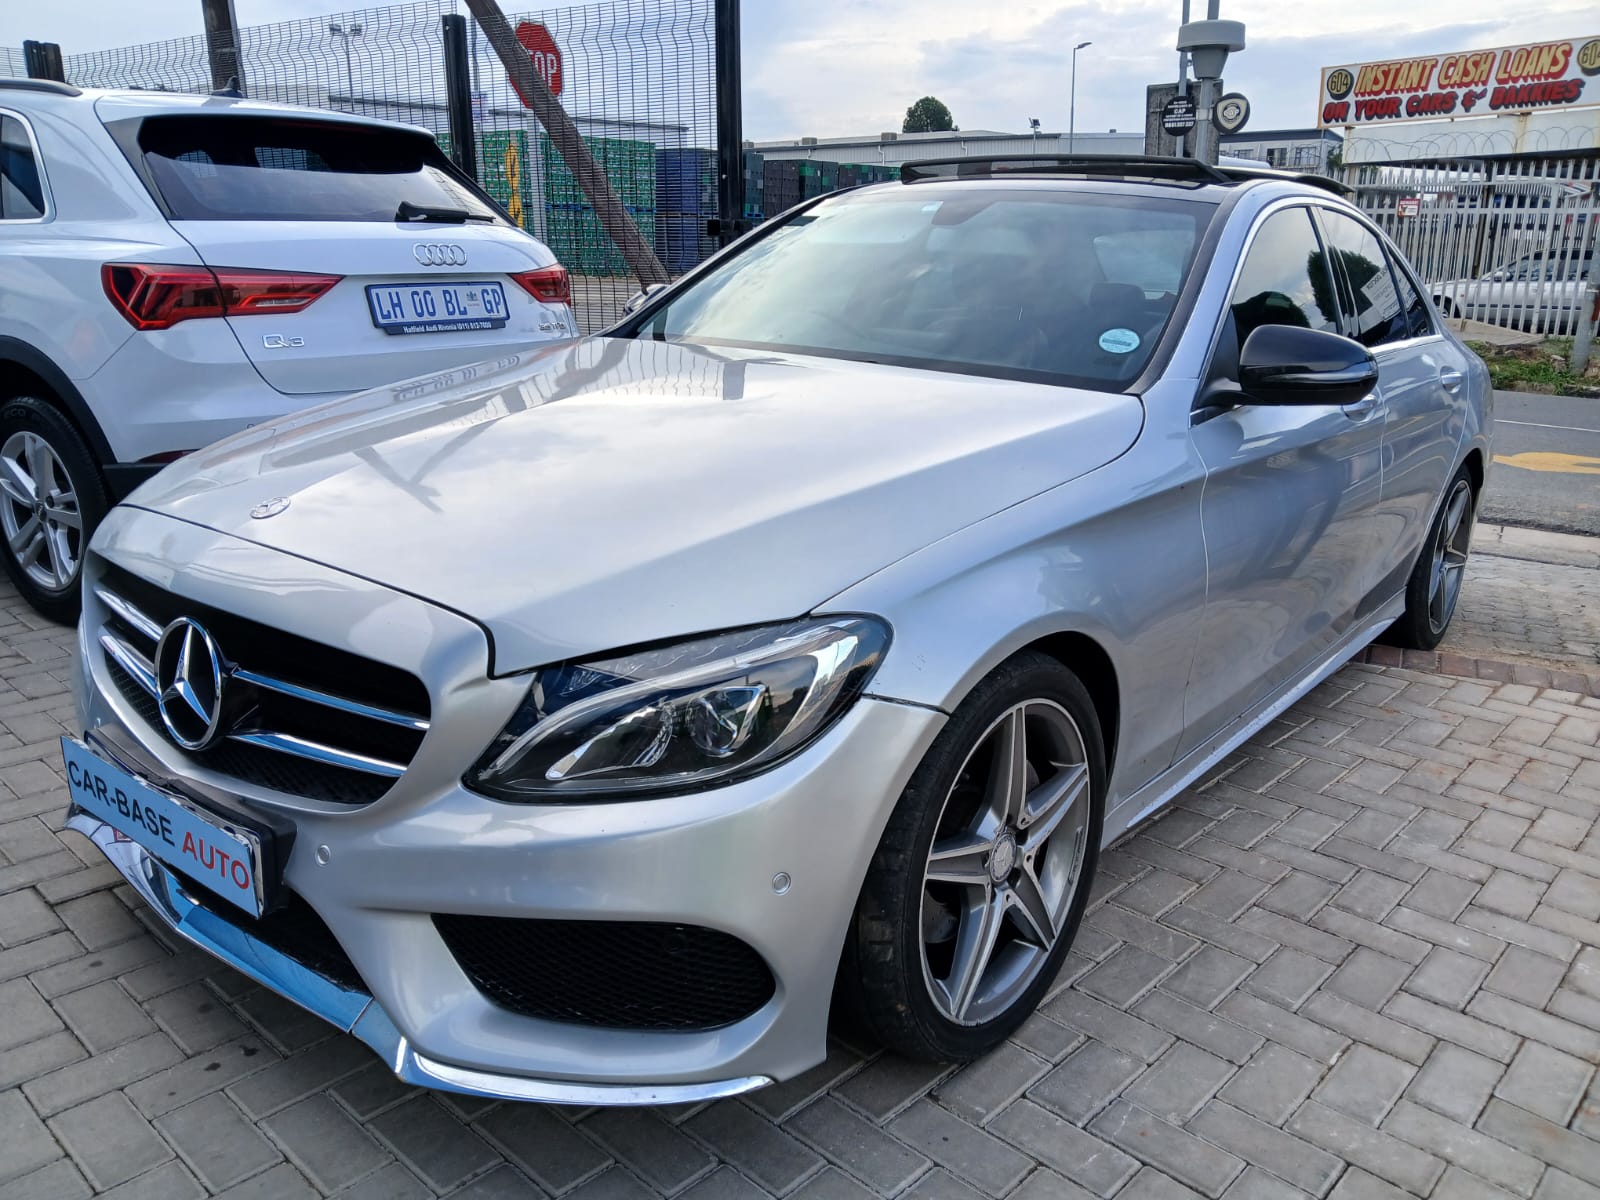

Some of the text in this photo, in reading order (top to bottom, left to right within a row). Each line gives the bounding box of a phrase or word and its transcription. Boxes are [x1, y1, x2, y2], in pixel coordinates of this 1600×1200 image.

[1354, 42, 1573, 97] INSTANT CASH LOANS
[1323, 101, 1350, 123] ON
[1355, 97, 1402, 121] YOUR
[1406, 91, 1459, 117] CARS
[1489, 78, 1585, 110] BAKKIES
[375, 291, 404, 320] LH
[442, 289, 468, 316] BL
[481, 288, 503, 315] GP
[262, 334, 305, 349] Q3
[68, 760, 249, 889] CAR-BASE AUTO
